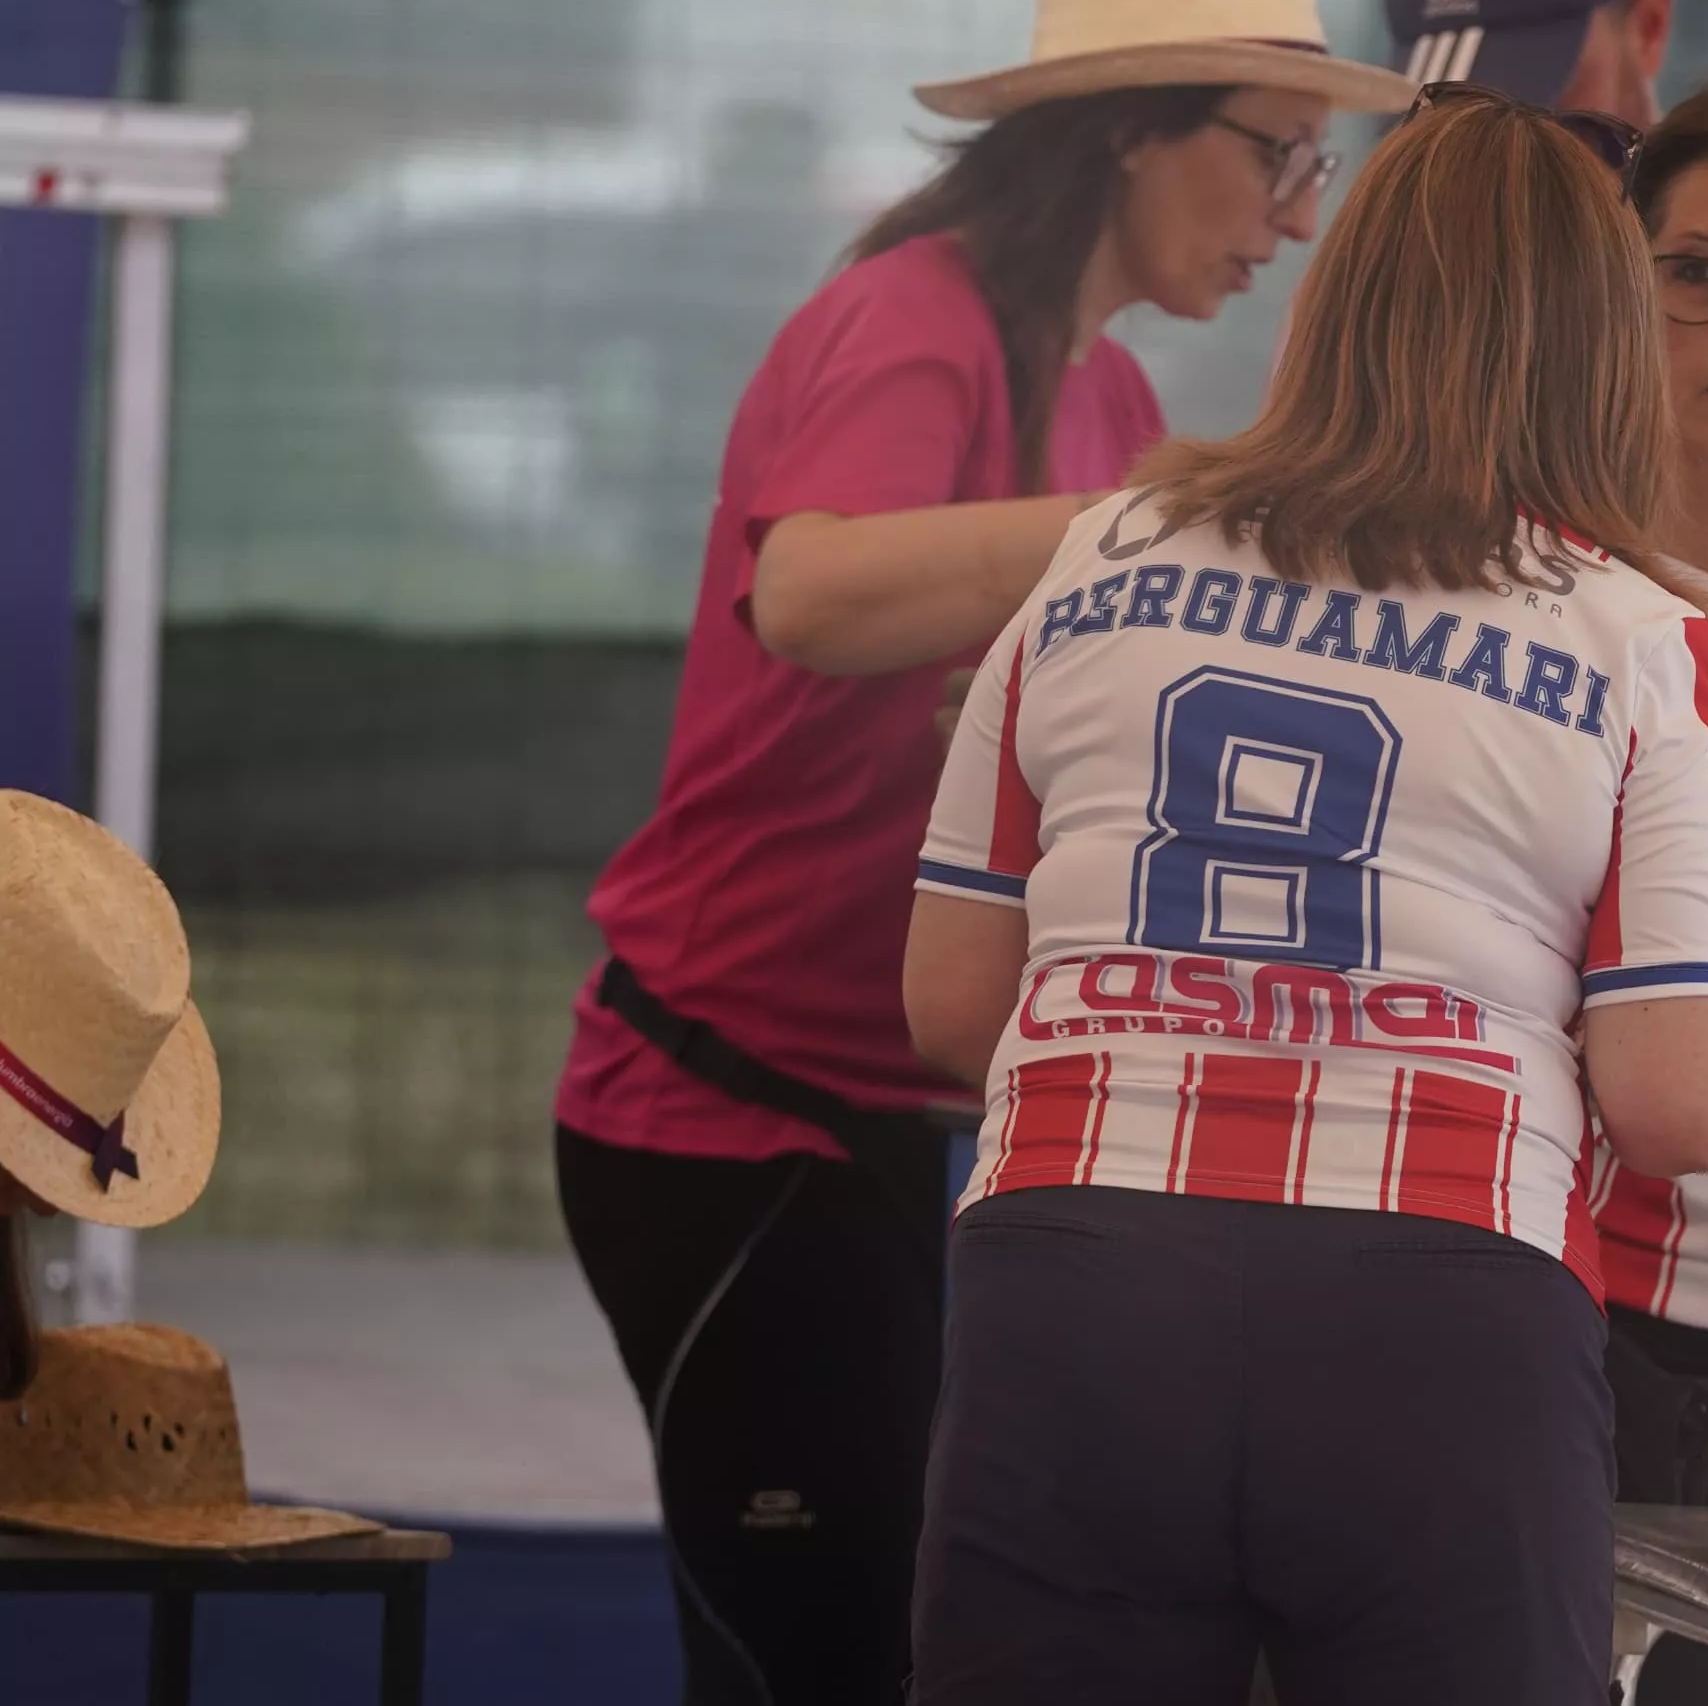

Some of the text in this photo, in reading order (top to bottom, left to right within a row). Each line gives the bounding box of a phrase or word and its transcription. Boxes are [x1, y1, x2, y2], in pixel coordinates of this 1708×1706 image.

[1034, 564, 1611, 738] BERGUAMARI
[1127, 665, 1404, 970] 8
[1050, 1017, 1226, 1039] GRUPO
